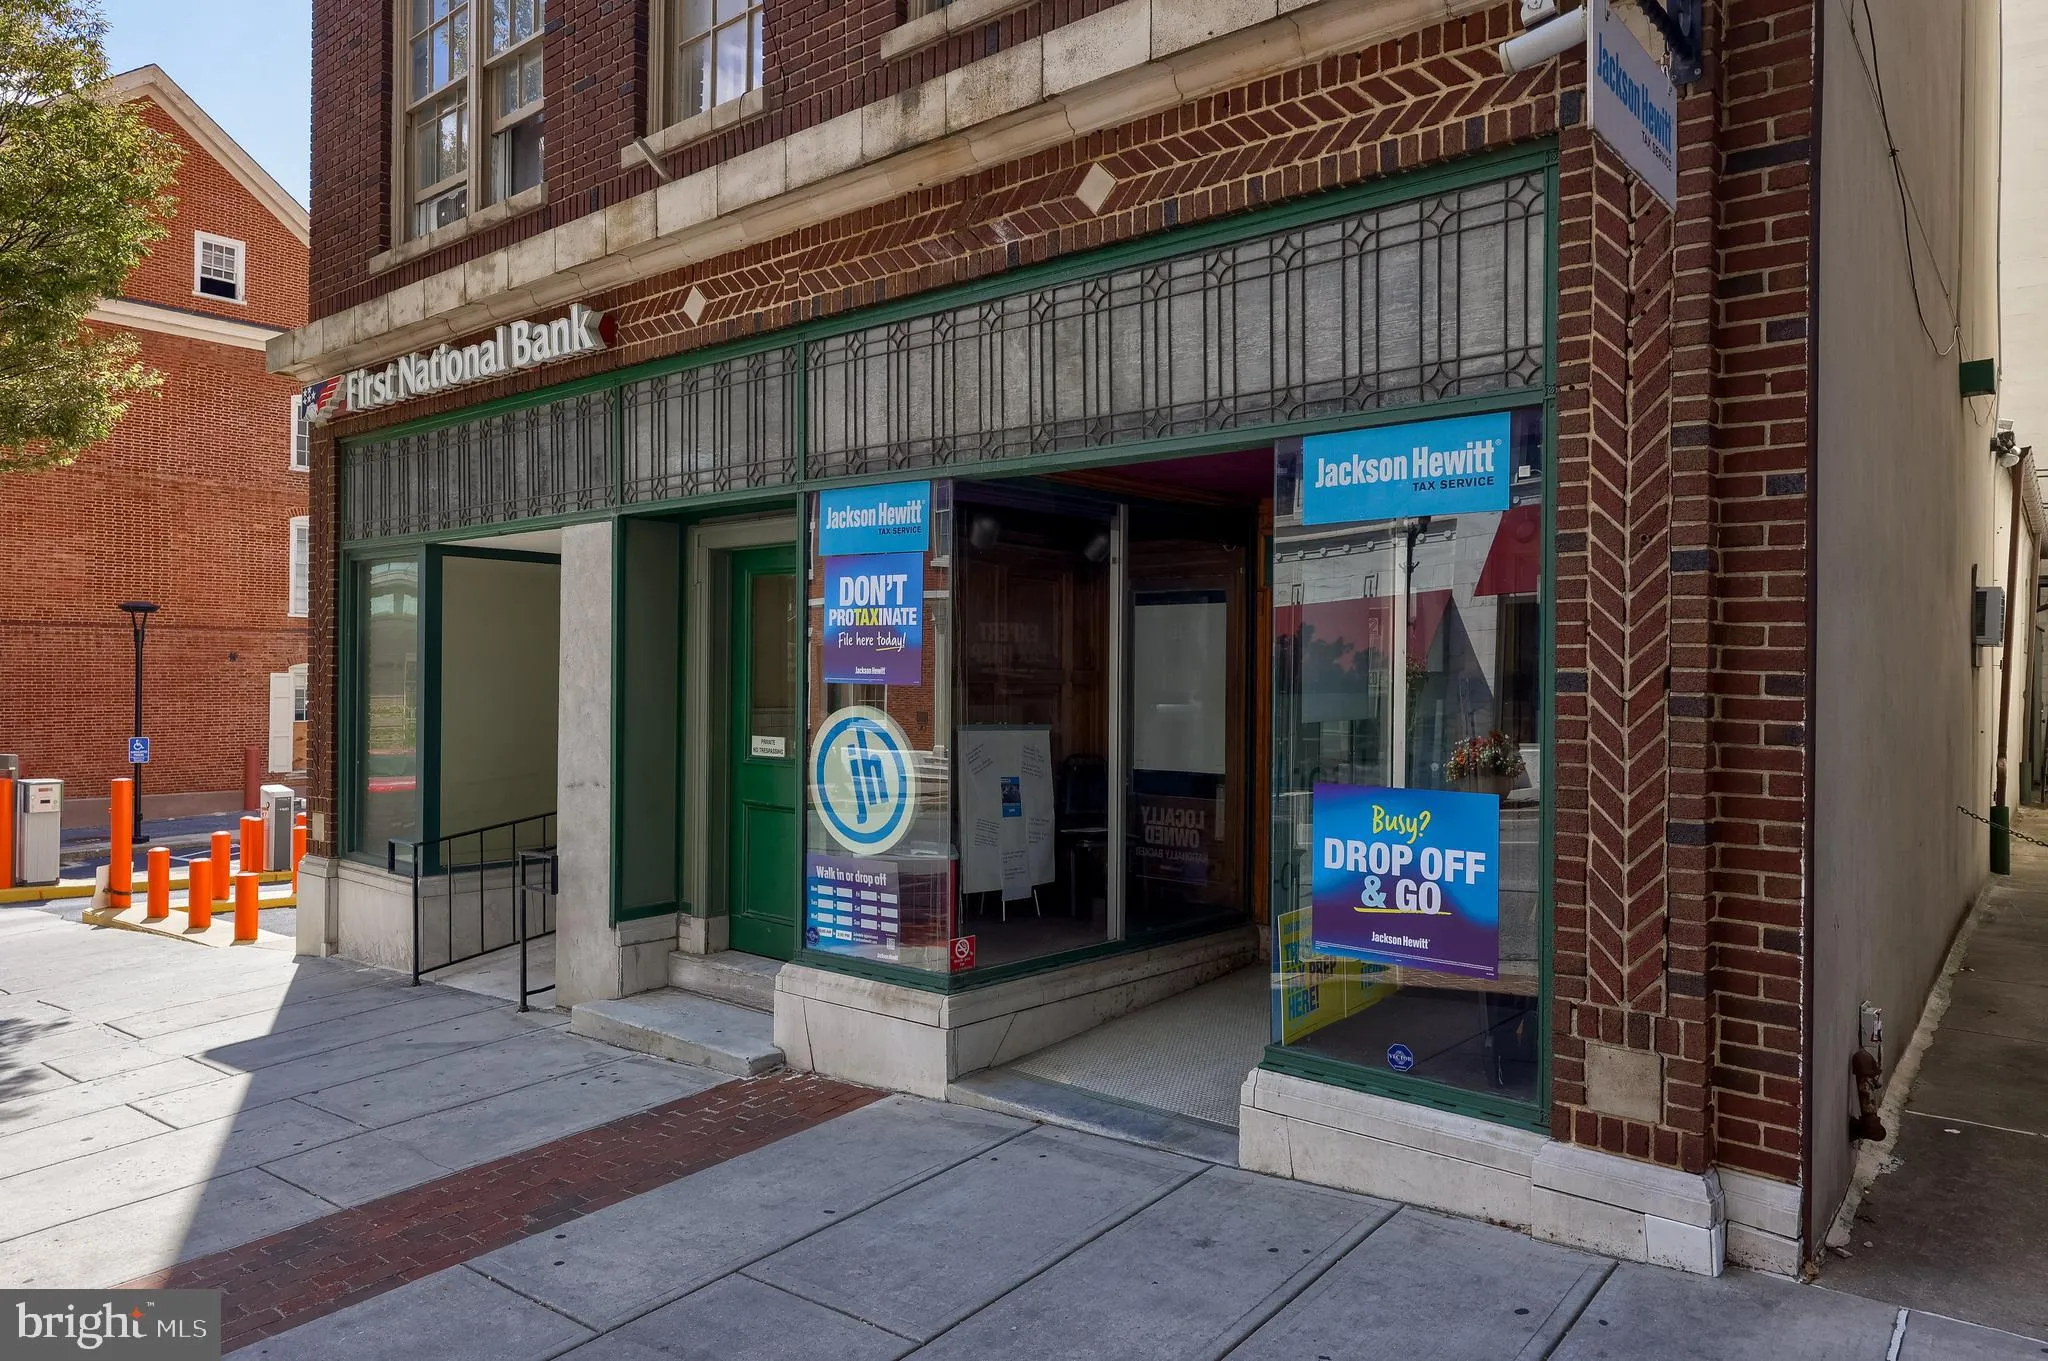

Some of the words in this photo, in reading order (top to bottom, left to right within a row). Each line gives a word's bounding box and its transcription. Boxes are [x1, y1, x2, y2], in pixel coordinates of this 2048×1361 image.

[1597, 32, 1640, 121] Jackson
[1641, 83, 1672, 154] Hewitt
[1641, 131, 1651, 148] TAX
[1652, 143, 1672, 172] SERVICE
[346, 362, 398, 411] First
[397, 326, 507, 398] National
[510, 303, 596, 368] Bank
[1314, 453, 1407, 488] Jackson
[1412, 439, 1495, 479] Hewitt
[1412, 481, 1436, 492] TAX
[1440, 475, 1495, 490] SERVICE
[826, 504, 876, 530] Jackson
[878, 500, 922, 526] Hewitt
[878, 527, 891, 535] TAX
[893, 526, 921, 534] SERVICE
[839, 574, 908, 607] DON'T
[828, 607, 917, 627] PROTAXINATE
[838, 632, 853, 649] File
[855, 632, 874, 646] here
[876, 632, 906, 652] today!
[855, 666, 871, 675] Jackson
[1372, 804, 1431, 844] Busy?
[816, 865, 836, 880] Walk
[836, 868, 844, 880] in
[846, 872, 854, 882] or
[855, 870, 873, 887] drop
[874, 873, 887, 886] off
[1324, 837, 1412, 877] DROP
[1420, 846, 1486, 885] OFF
[1361, 875, 1387, 908] &
[1395, 878, 1442, 915] GO
[1371, 931, 1402, 946] Jackson
[1402, 935, 1429, 950] Hewitt
[1288, 984, 1320, 1022] HERE!
